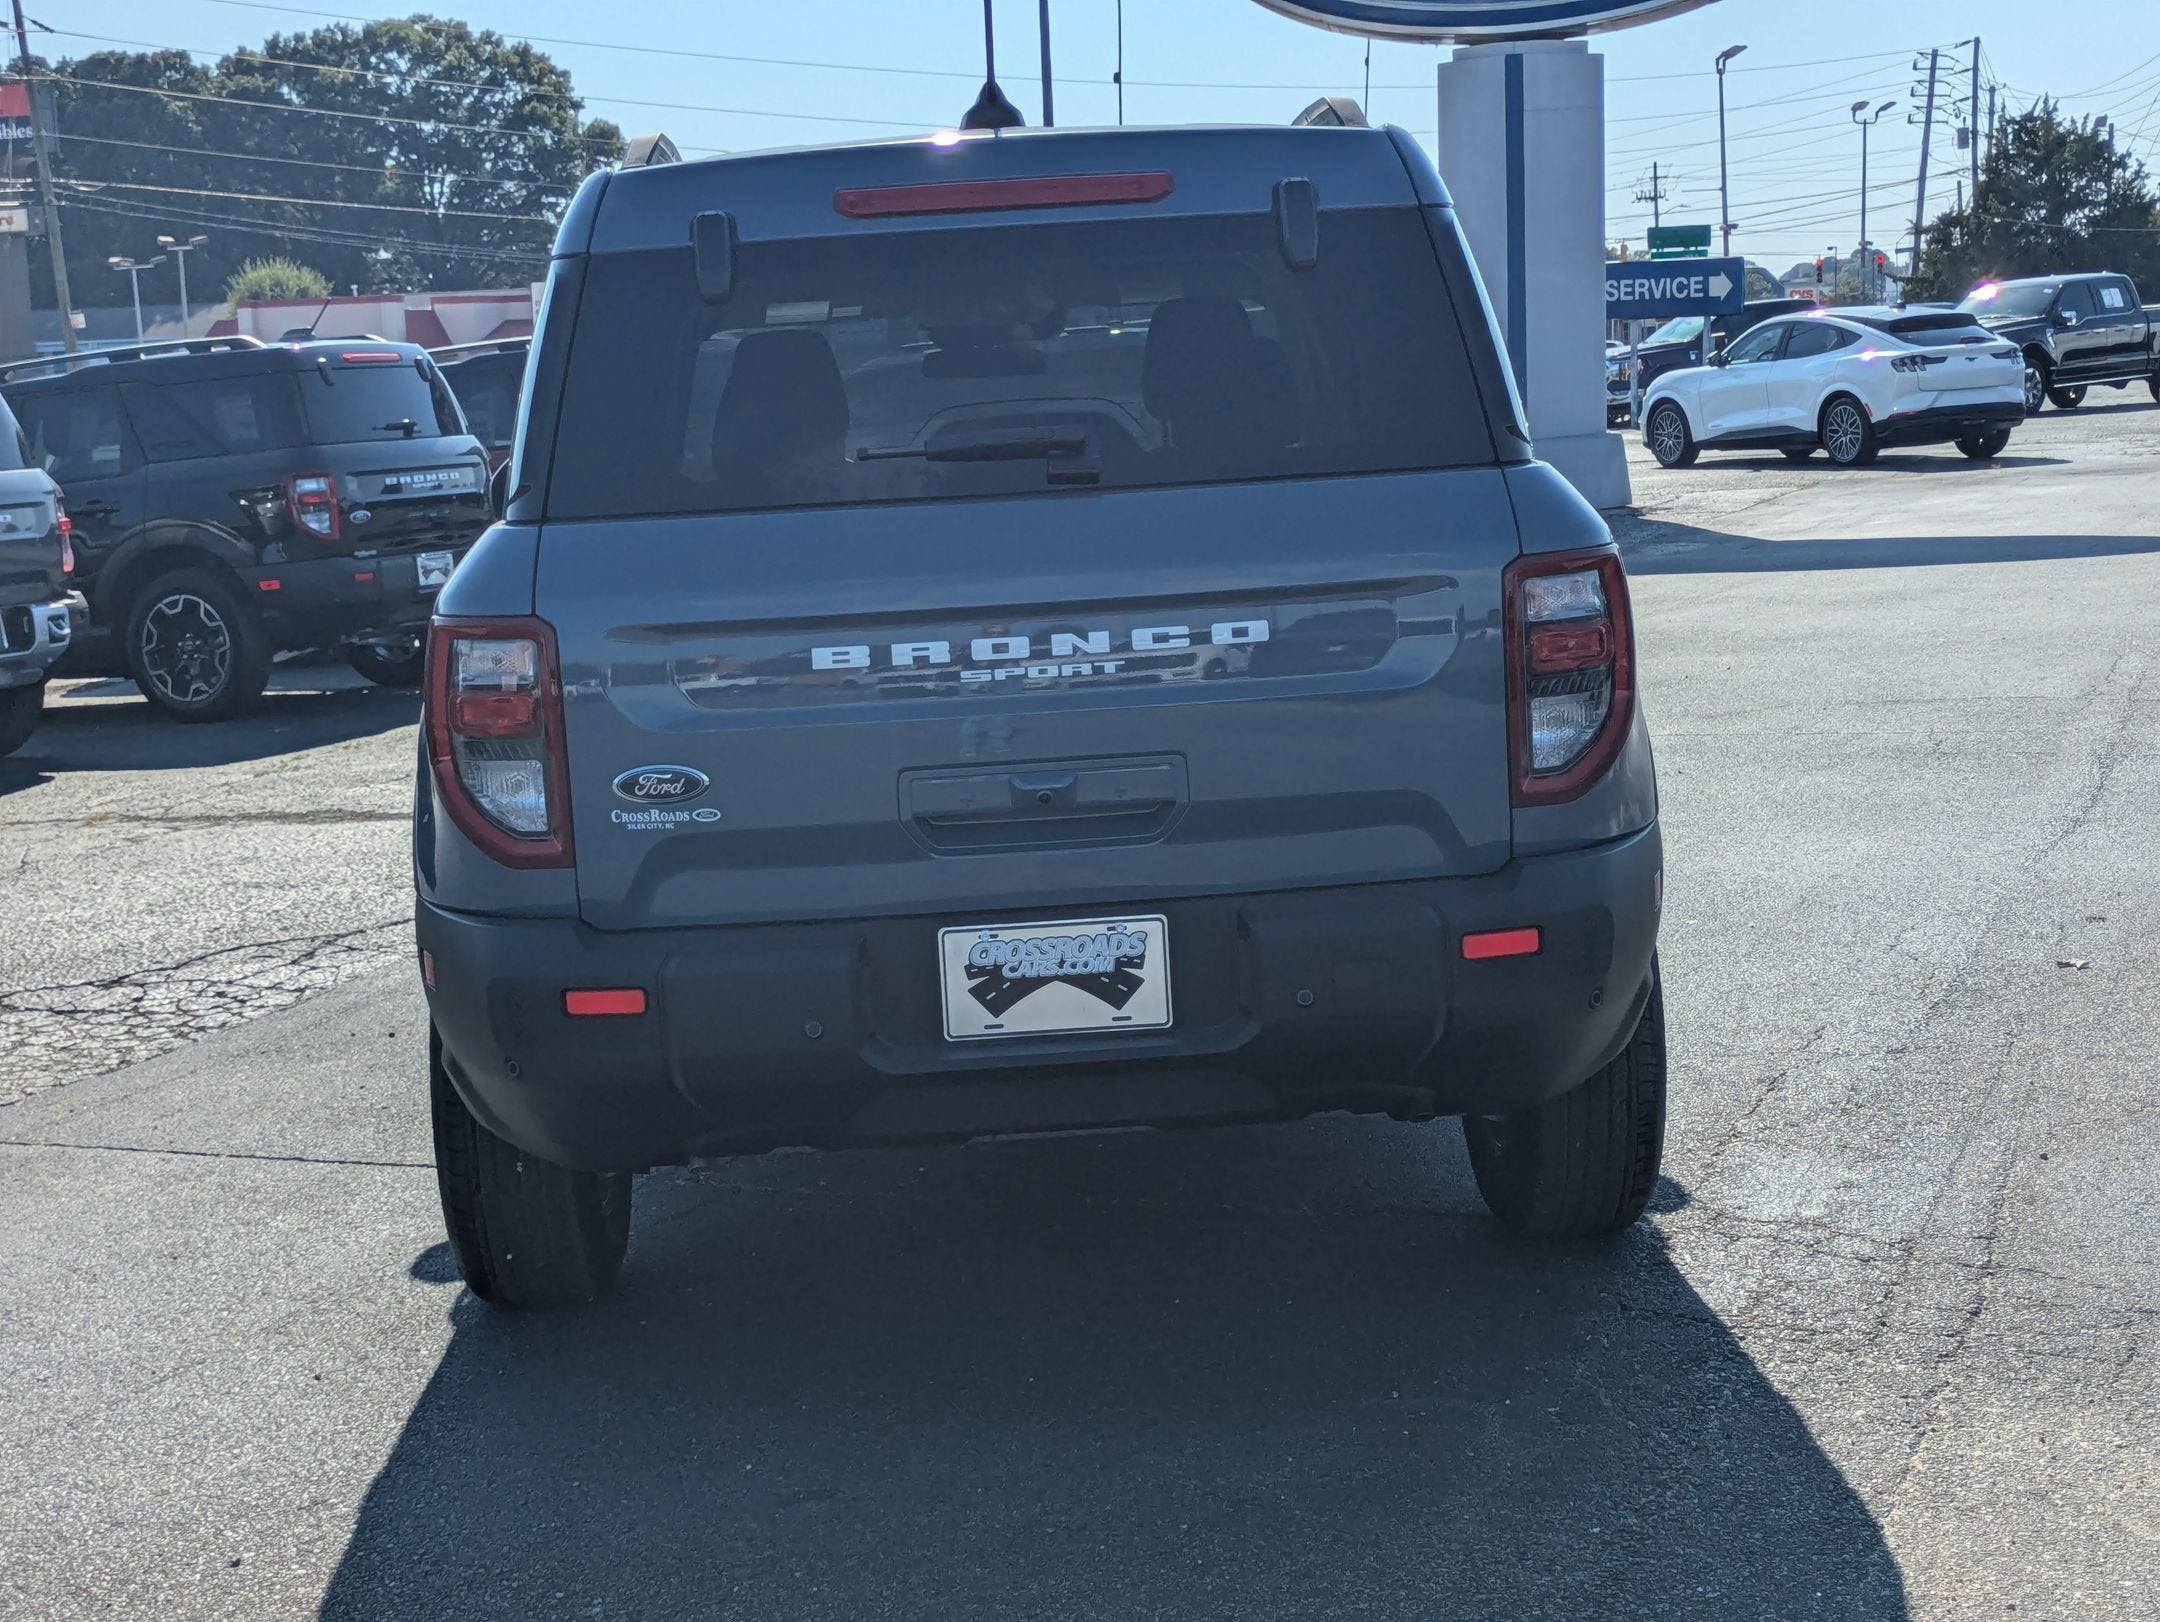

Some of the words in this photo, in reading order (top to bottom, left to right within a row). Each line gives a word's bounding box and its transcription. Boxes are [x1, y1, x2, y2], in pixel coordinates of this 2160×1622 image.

[1605, 276, 1704, 301] SERVICE
[385, 471, 460, 486] BRONCO
[811, 619, 1270, 670] BRONCO
[959, 660, 1126, 683] SPORT
[634, 773, 686, 796] Ford
[968, 930, 1149, 967] CROSSROADS
[1001, 956, 1116, 979] CARS.COM
